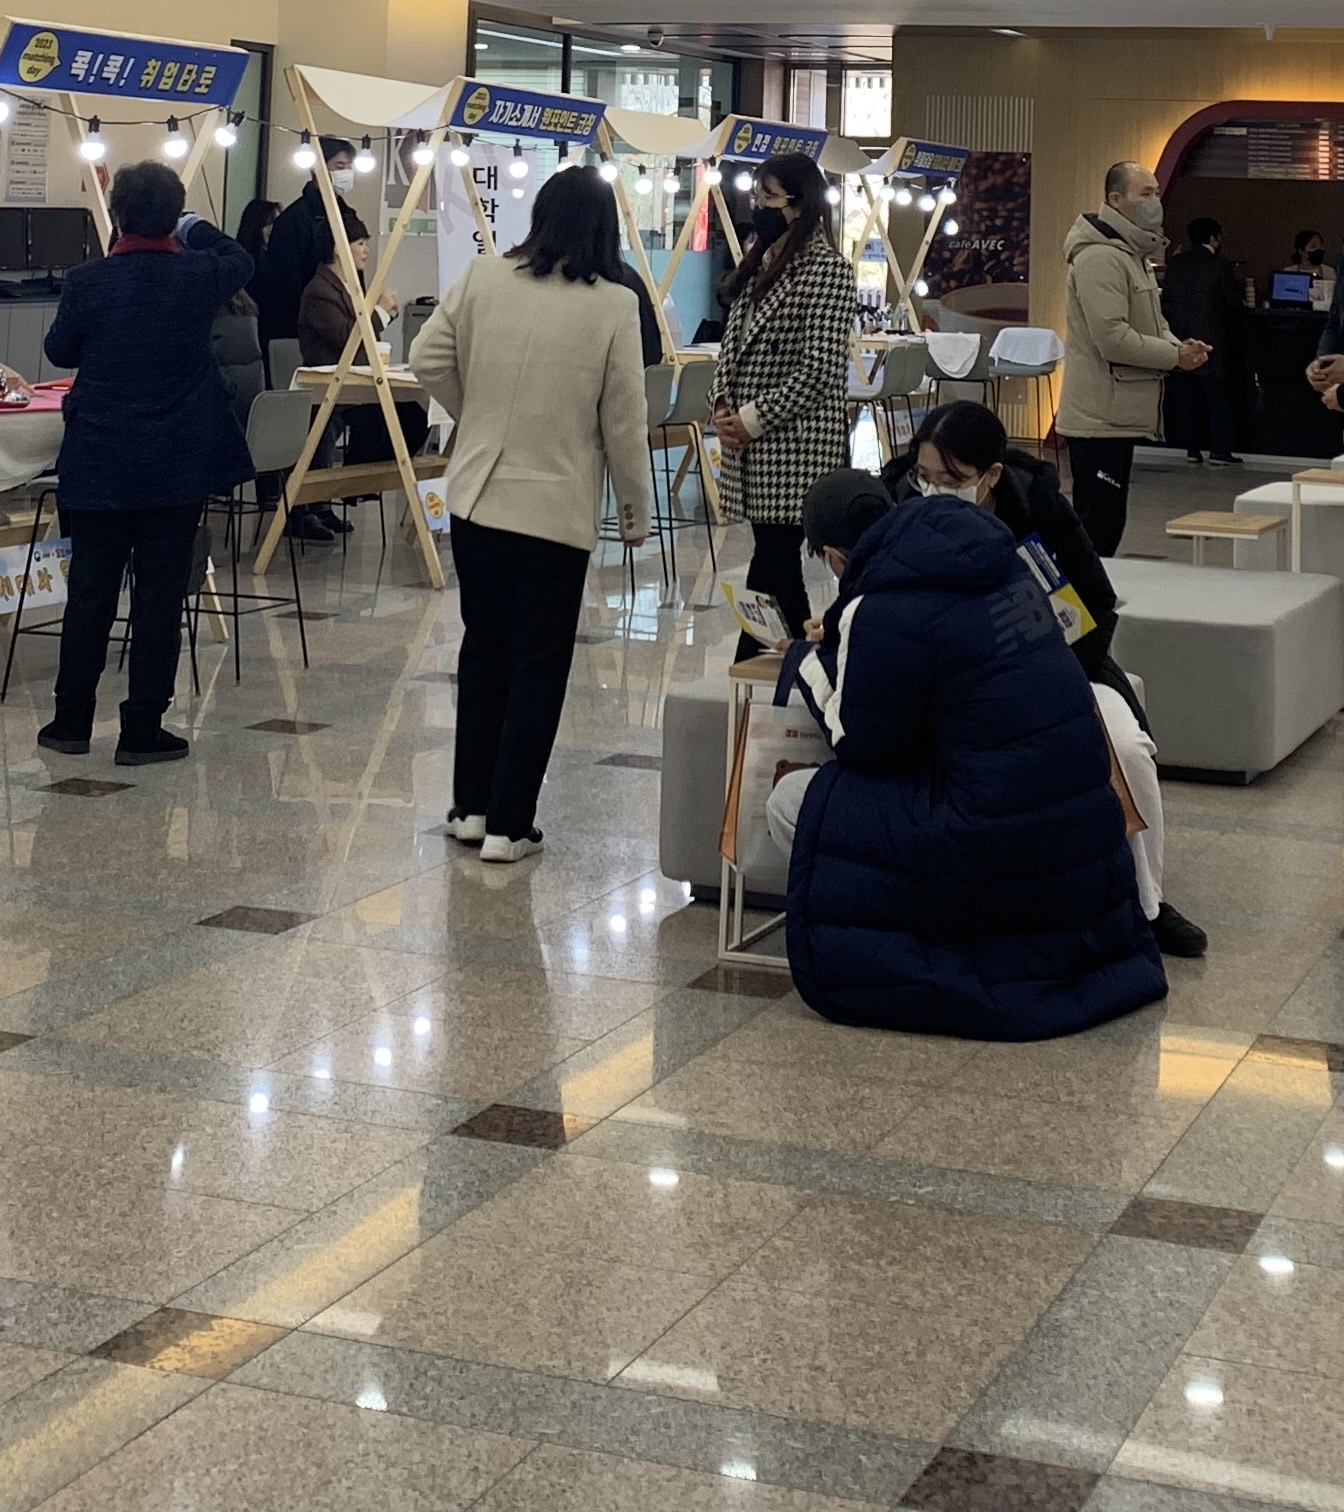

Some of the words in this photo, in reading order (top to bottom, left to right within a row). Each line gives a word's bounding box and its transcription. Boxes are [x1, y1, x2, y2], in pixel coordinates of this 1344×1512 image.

[140, 58, 218, 94] 취업타로
[488, 99, 543, 129] 자기소개서
[971, 239, 1006, 251] AVEC
